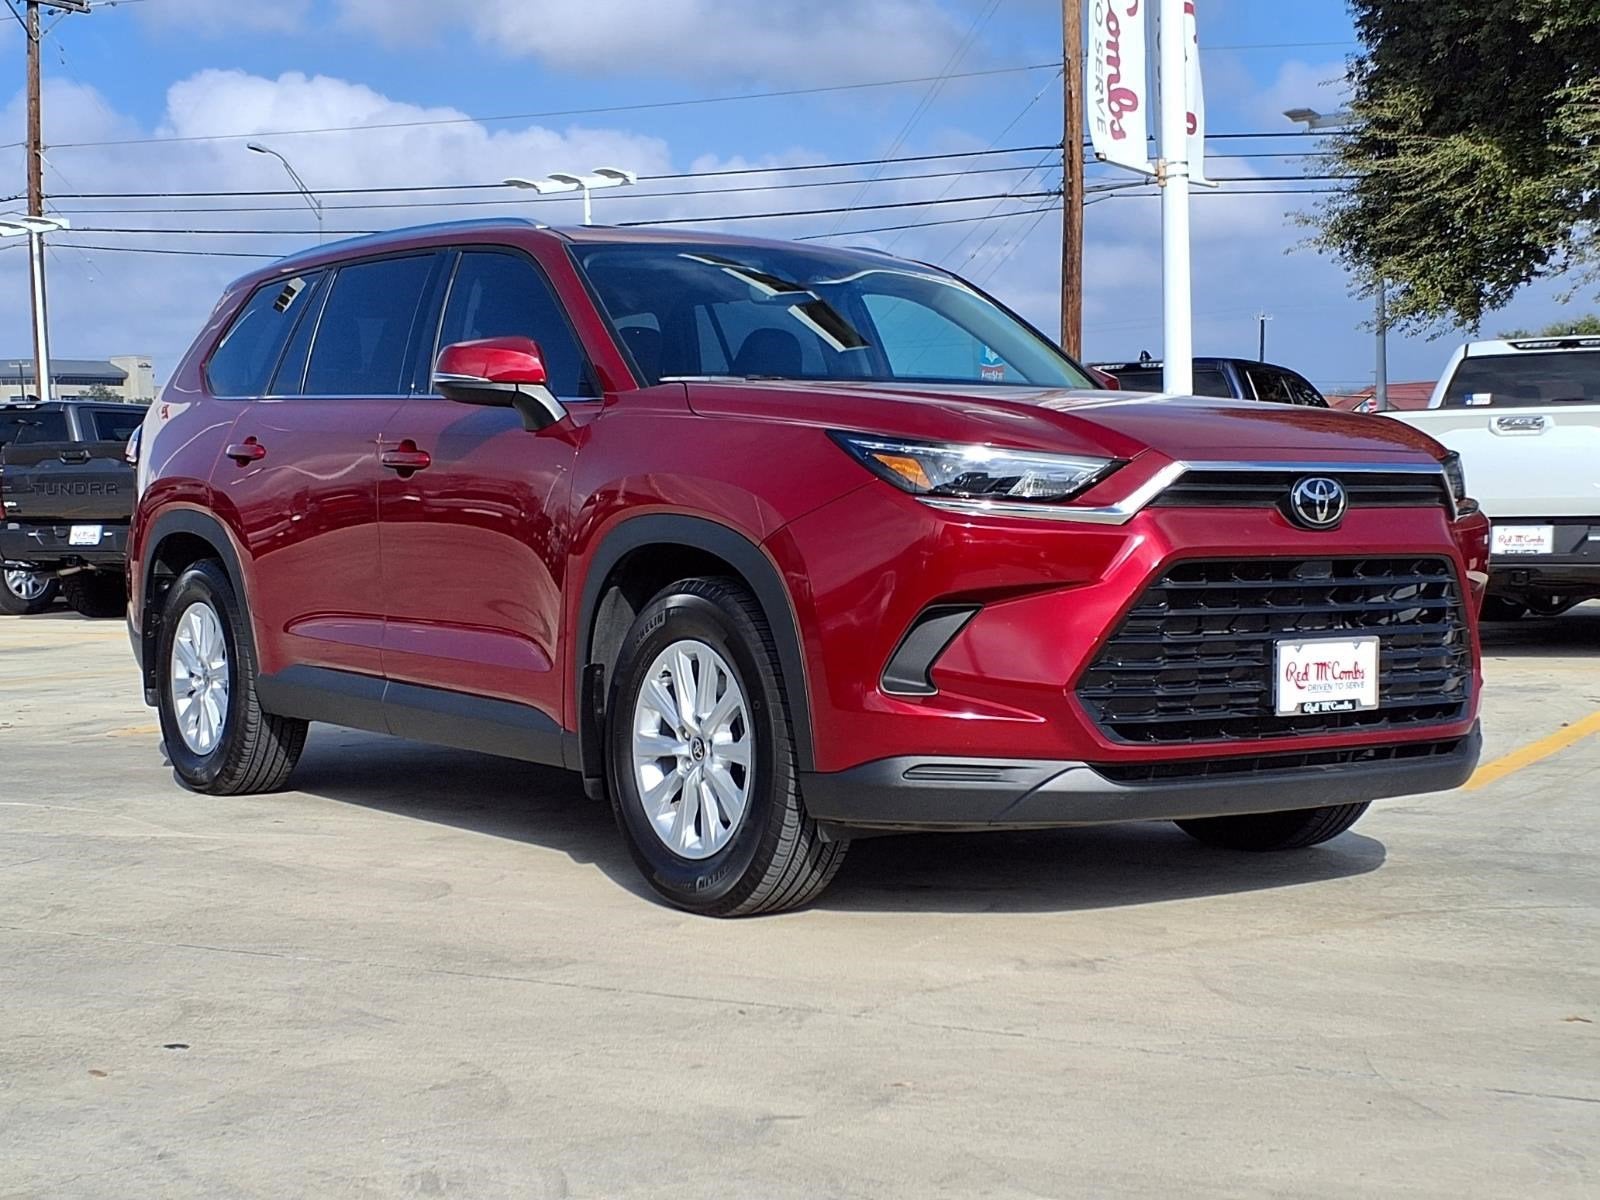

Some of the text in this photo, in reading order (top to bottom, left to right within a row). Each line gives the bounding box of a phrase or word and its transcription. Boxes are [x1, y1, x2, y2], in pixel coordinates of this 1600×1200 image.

[1094, 37, 1107, 136] SERVE
[31, 482, 120, 497] TUNDRA
[1286, 660, 1366, 689] Red McCombs
[1308, 681, 1365, 691] DRIVEN TO SERVE
[1303, 702, 1319, 714] Red
